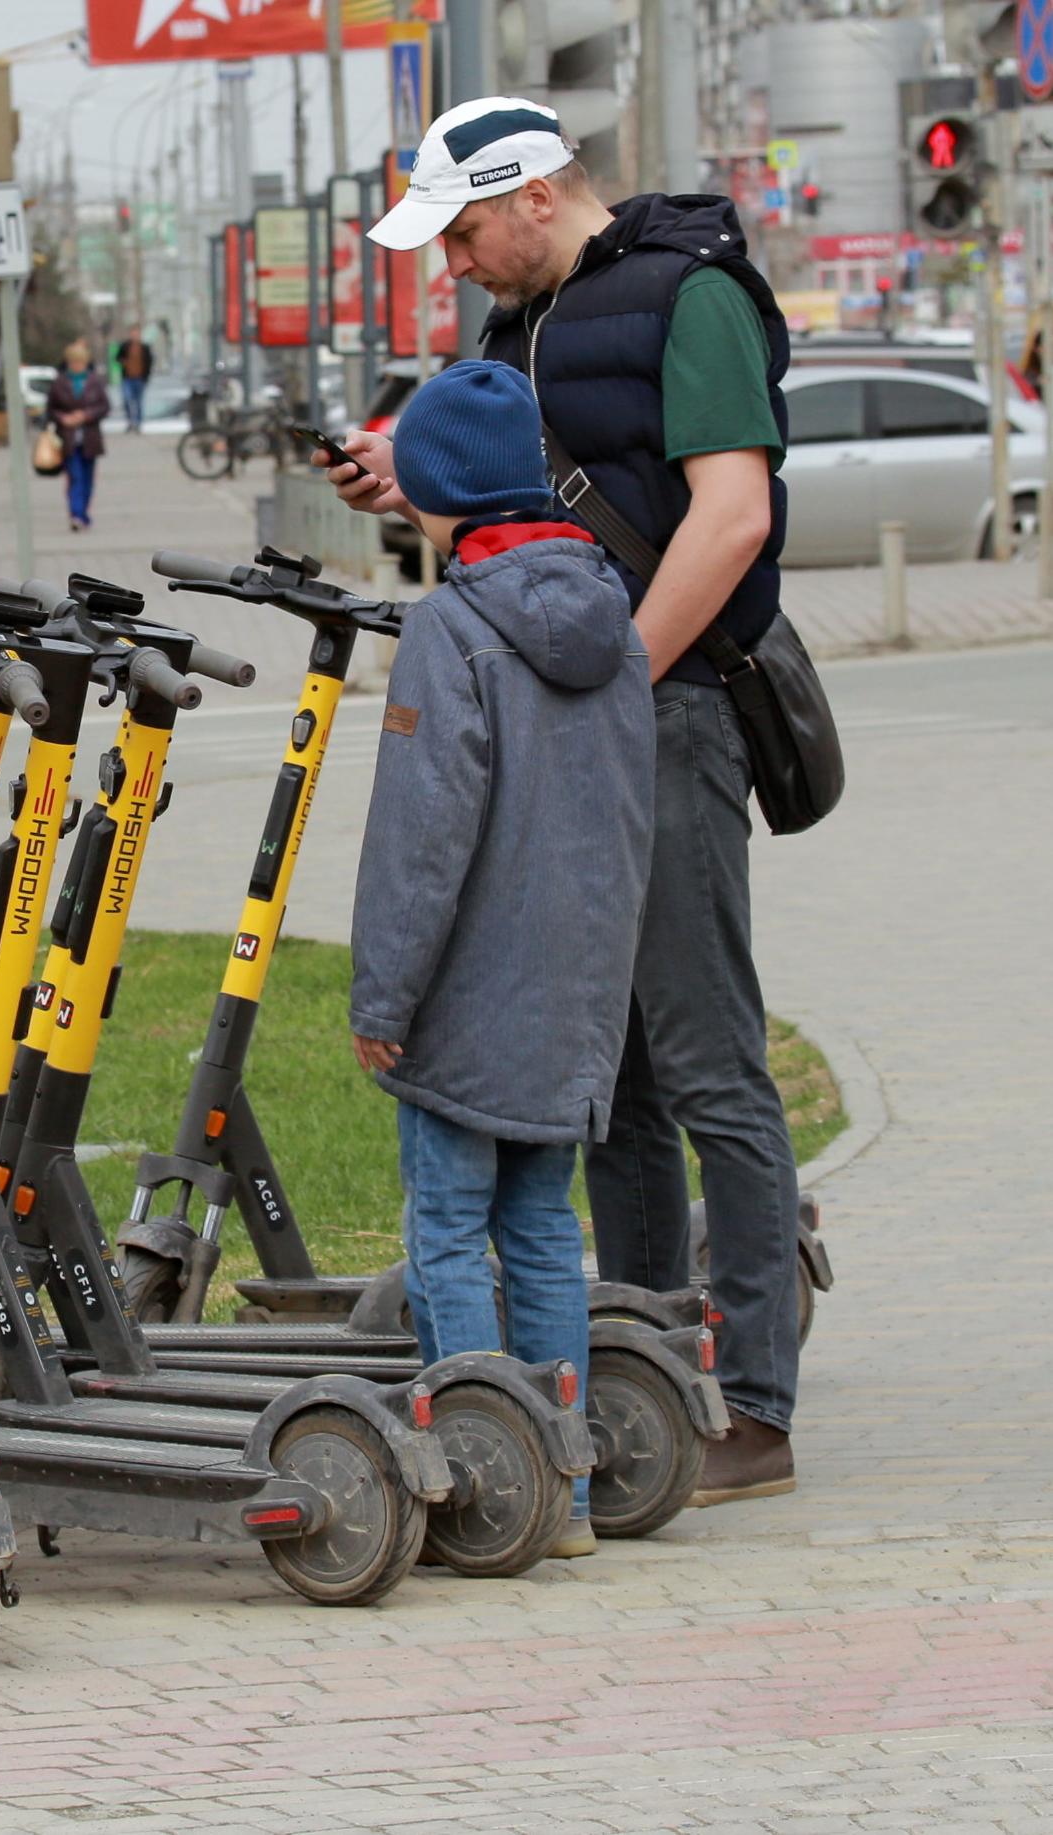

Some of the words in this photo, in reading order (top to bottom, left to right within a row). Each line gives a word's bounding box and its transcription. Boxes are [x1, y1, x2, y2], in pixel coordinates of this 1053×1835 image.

[472, 165, 520, 185] PETRONAS
[10, 819, 49, 935] WHOOSH
[106, 802, 146, 914] WHOOSH
[255, 1180, 281, 1221] AC66
[73, 1264, 96, 1306] CF14
